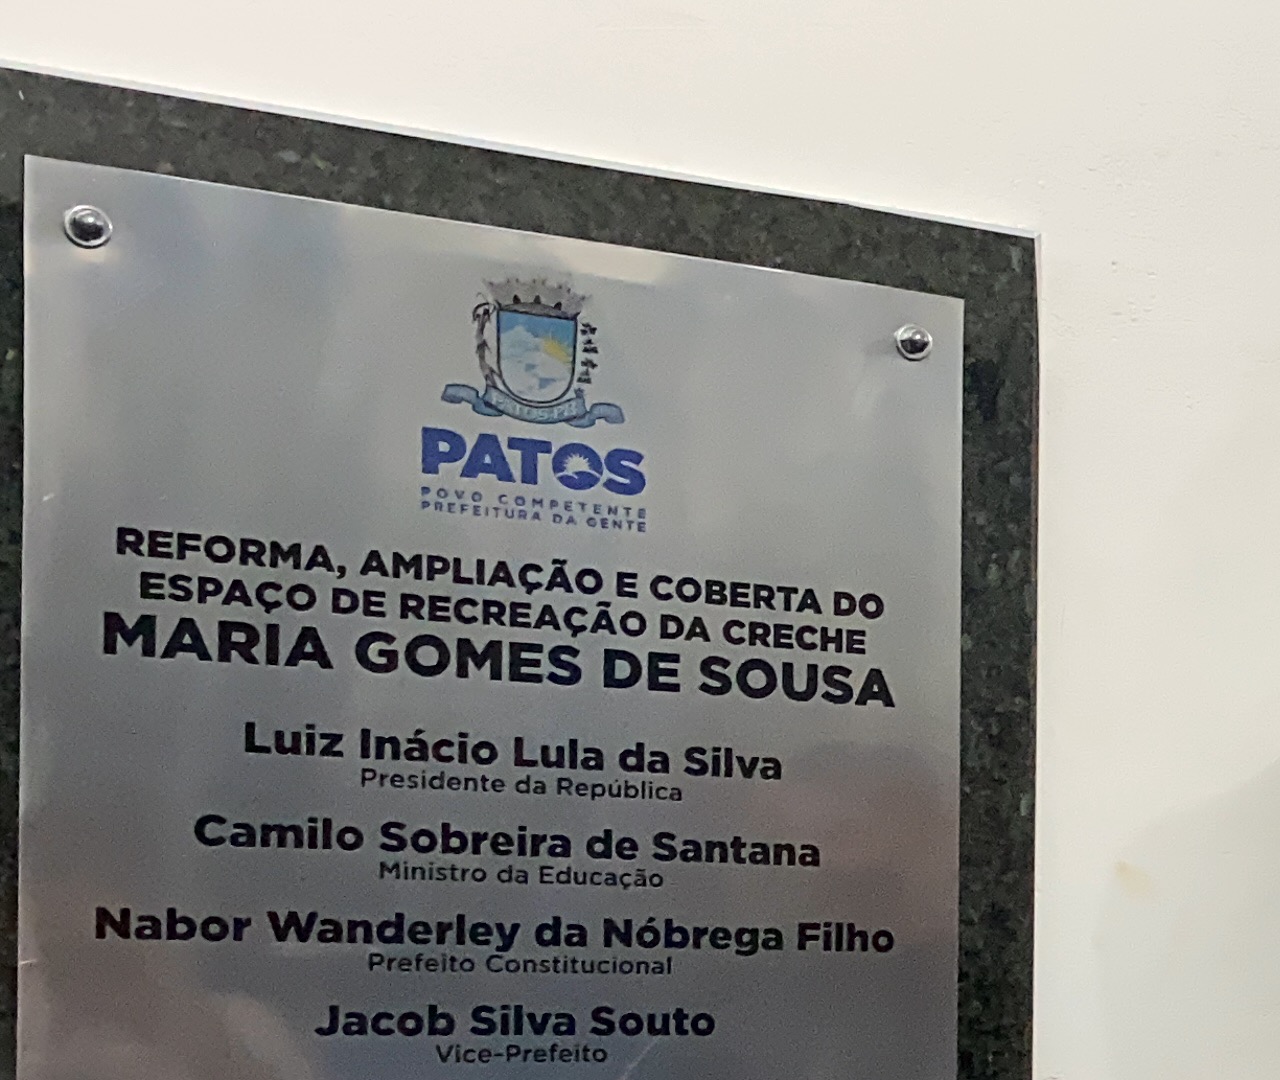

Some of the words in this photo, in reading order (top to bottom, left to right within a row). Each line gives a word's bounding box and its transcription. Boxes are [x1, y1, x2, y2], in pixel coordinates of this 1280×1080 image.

[421, 426, 646, 496] PATOS
[421, 486, 483, 502] POVO
[499, 494, 646, 519] COMPETENTE
[421, 501, 542, 521] PREFEITURA
[552, 514, 577, 526] DA
[587, 517, 646, 532] GENTE
[117, 527, 346, 579] REFORMA,
[360, 550, 603, 595] AMPLIAÇÃO
[616, 572, 638, 598] E
[650, 575, 822, 614] COBERTA
[834, 592, 884, 619] DO
[140, 572, 316, 614] ESPAÇO
[332, 588, 386, 617] DE
[400, 593, 646, 638] RECREAÇÃO
[660, 614, 710, 642] DA
[723, 620, 866, 654] CRECHE
[103, 612, 333, 669] MARIA
[355, 631, 581, 685] GOMES
[604, 649, 680, 692] DE
[699, 656, 895, 707] SOUSA
[245, 722, 343, 757] Luiz
[361, 728, 498, 765] Inácio
[514, 737, 604, 771] Lula
[619, 742, 669, 773] da
[684, 747, 781, 780] Silva
[361, 768, 505, 793] Presidente
[515, 775, 546, 794] da
[557, 777, 682, 801] República
[194, 814, 363, 850] Camilo
[380, 822, 571, 857] Sobreira
[586, 829, 638, 860] de
[652, 832, 820, 867] Santana
[380, 862, 487, 882] Ministro
[497, 865, 528, 884] da
[539, 866, 663, 889] Educação
[96, 907, 251, 941] Nabor
[267, 911, 520, 952] Wanderley
[535, 916, 587, 947] da
[604, 917, 783, 956] Nóbrega
[798, 922, 894, 953] Filho
[368, 953, 475, 972] Prefeito
[486, 955, 672, 974] Constitucional
[315, 1004, 455, 1036] Jacob
[470, 1005, 576, 1036] Silva
[590, 1006, 715, 1036] Souto
[436, 1043, 607, 1063] Vice-Prefeito
